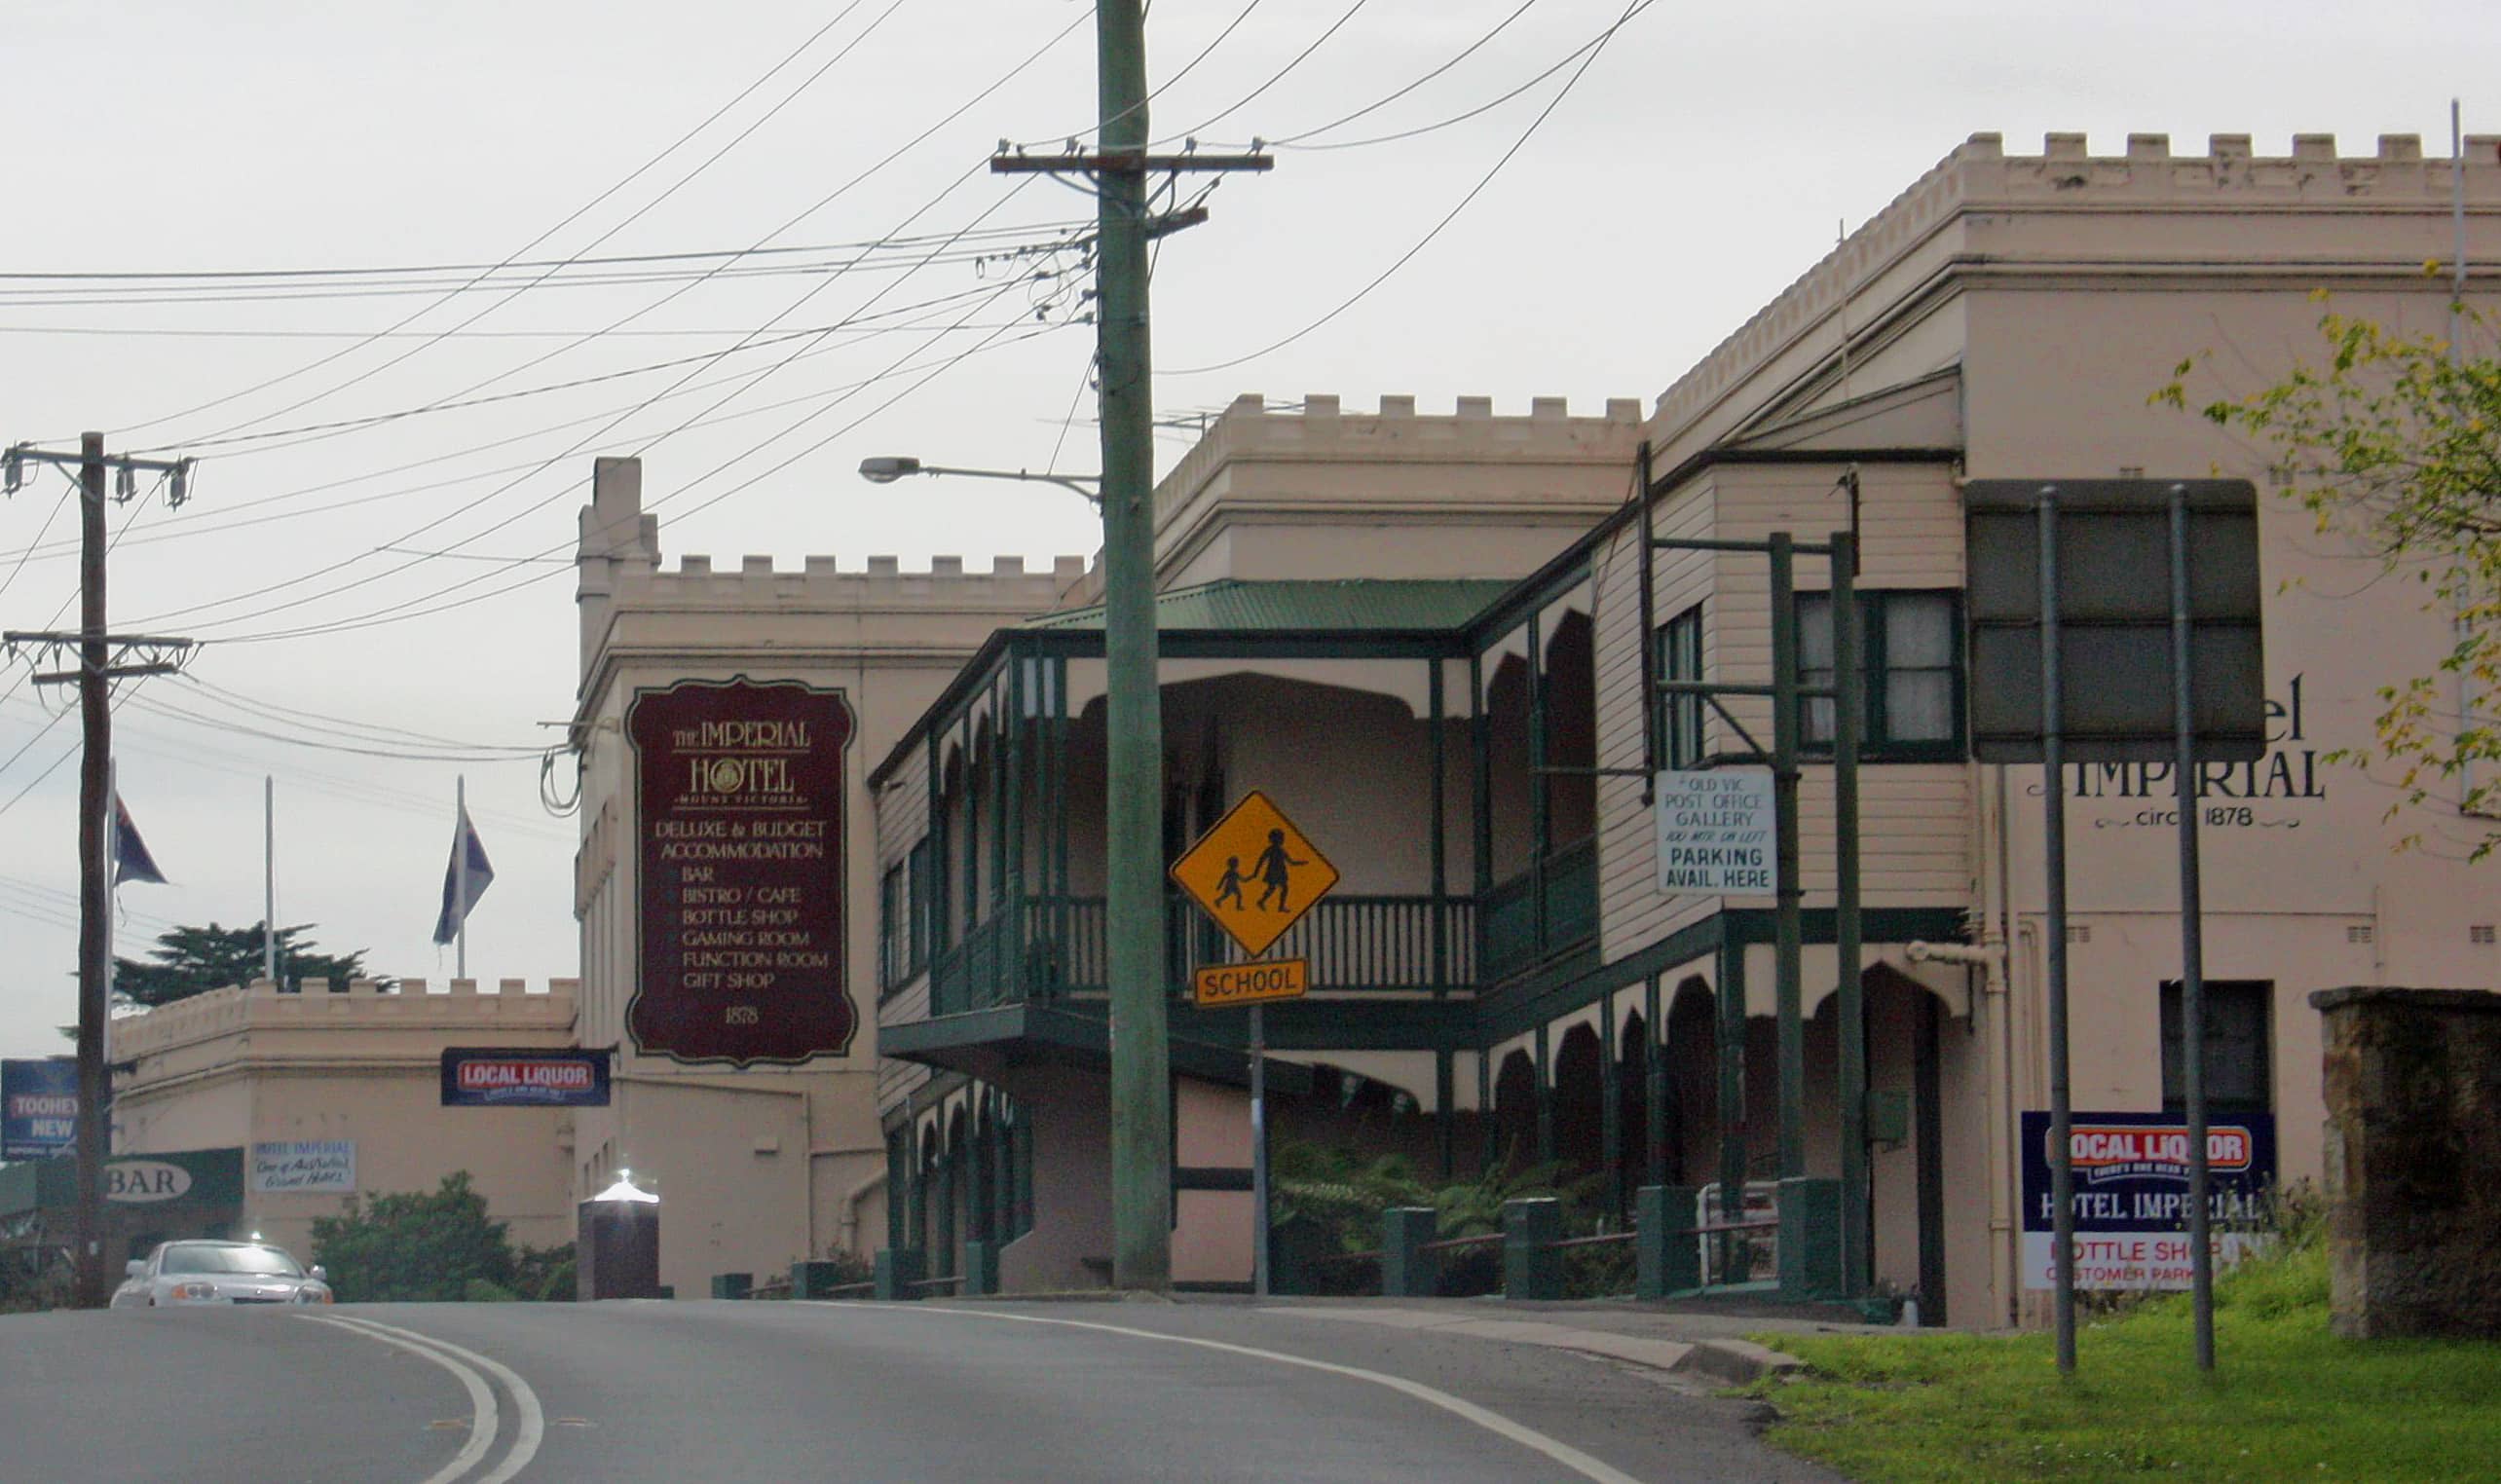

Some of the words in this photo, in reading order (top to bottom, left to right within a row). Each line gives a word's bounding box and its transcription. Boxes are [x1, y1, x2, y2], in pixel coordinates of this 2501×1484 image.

[701, 721, 810, 747] IMPERIAL
[691, 758, 795, 794] HOTEL
[1690, 778, 1717, 791] OLD
[1721, 778, 1744, 791] VIC
[1665, 794, 1701, 808] POST
[1713, 794, 1762, 808] OFFICE
[1675, 811, 1754, 826] GALLERY
[2137, 807, 2180, 826] circ
[2205, 806, 2253, 827] 1878
[655, 821, 727, 837] DELUXE
[731, 824, 746, 837] &
[752, 821, 826, 837] BUDGET
[660, 843, 824, 859] ACCOMMODATION
[1671, 847, 1764, 866] PARKING
[683, 866, 714, 881] BAR
[1666, 869, 1719, 887] AVAIL.
[1724, 870, 1770, 887] HERE
[683, 888, 741, 904] BISTRO
[758, 888, 801, 903] CAFE
[683, 909, 747, 924] BOTTLE
[752, 909, 799, 924] SHOP
[683, 931, 754, 946] GAMING
[759, 931, 810, 946] ROOM
[683, 951, 772, 967] FUNCTION
[777, 952, 828, 968] ROOM
[684, 973, 720, 988] GIFT
[728, 973, 775, 988] SHOP
[1205, 967, 1297, 997] SCHOOL
[726, 1006, 759, 1024] 1878
[465, 1065, 520, 1084] LOCAL
[17, 1097, 78, 1115] TOOHEY
[31, 1121, 73, 1137] NEW
[2070, 1134, 2141, 1160] OCAL
[108, 1170, 176, 1194] BAR
[2041, 1193, 2127, 1218] HTEL
[2154, 1242, 2221, 1262] SHP
[2046, 1268, 2146, 1281] CSTOMER
